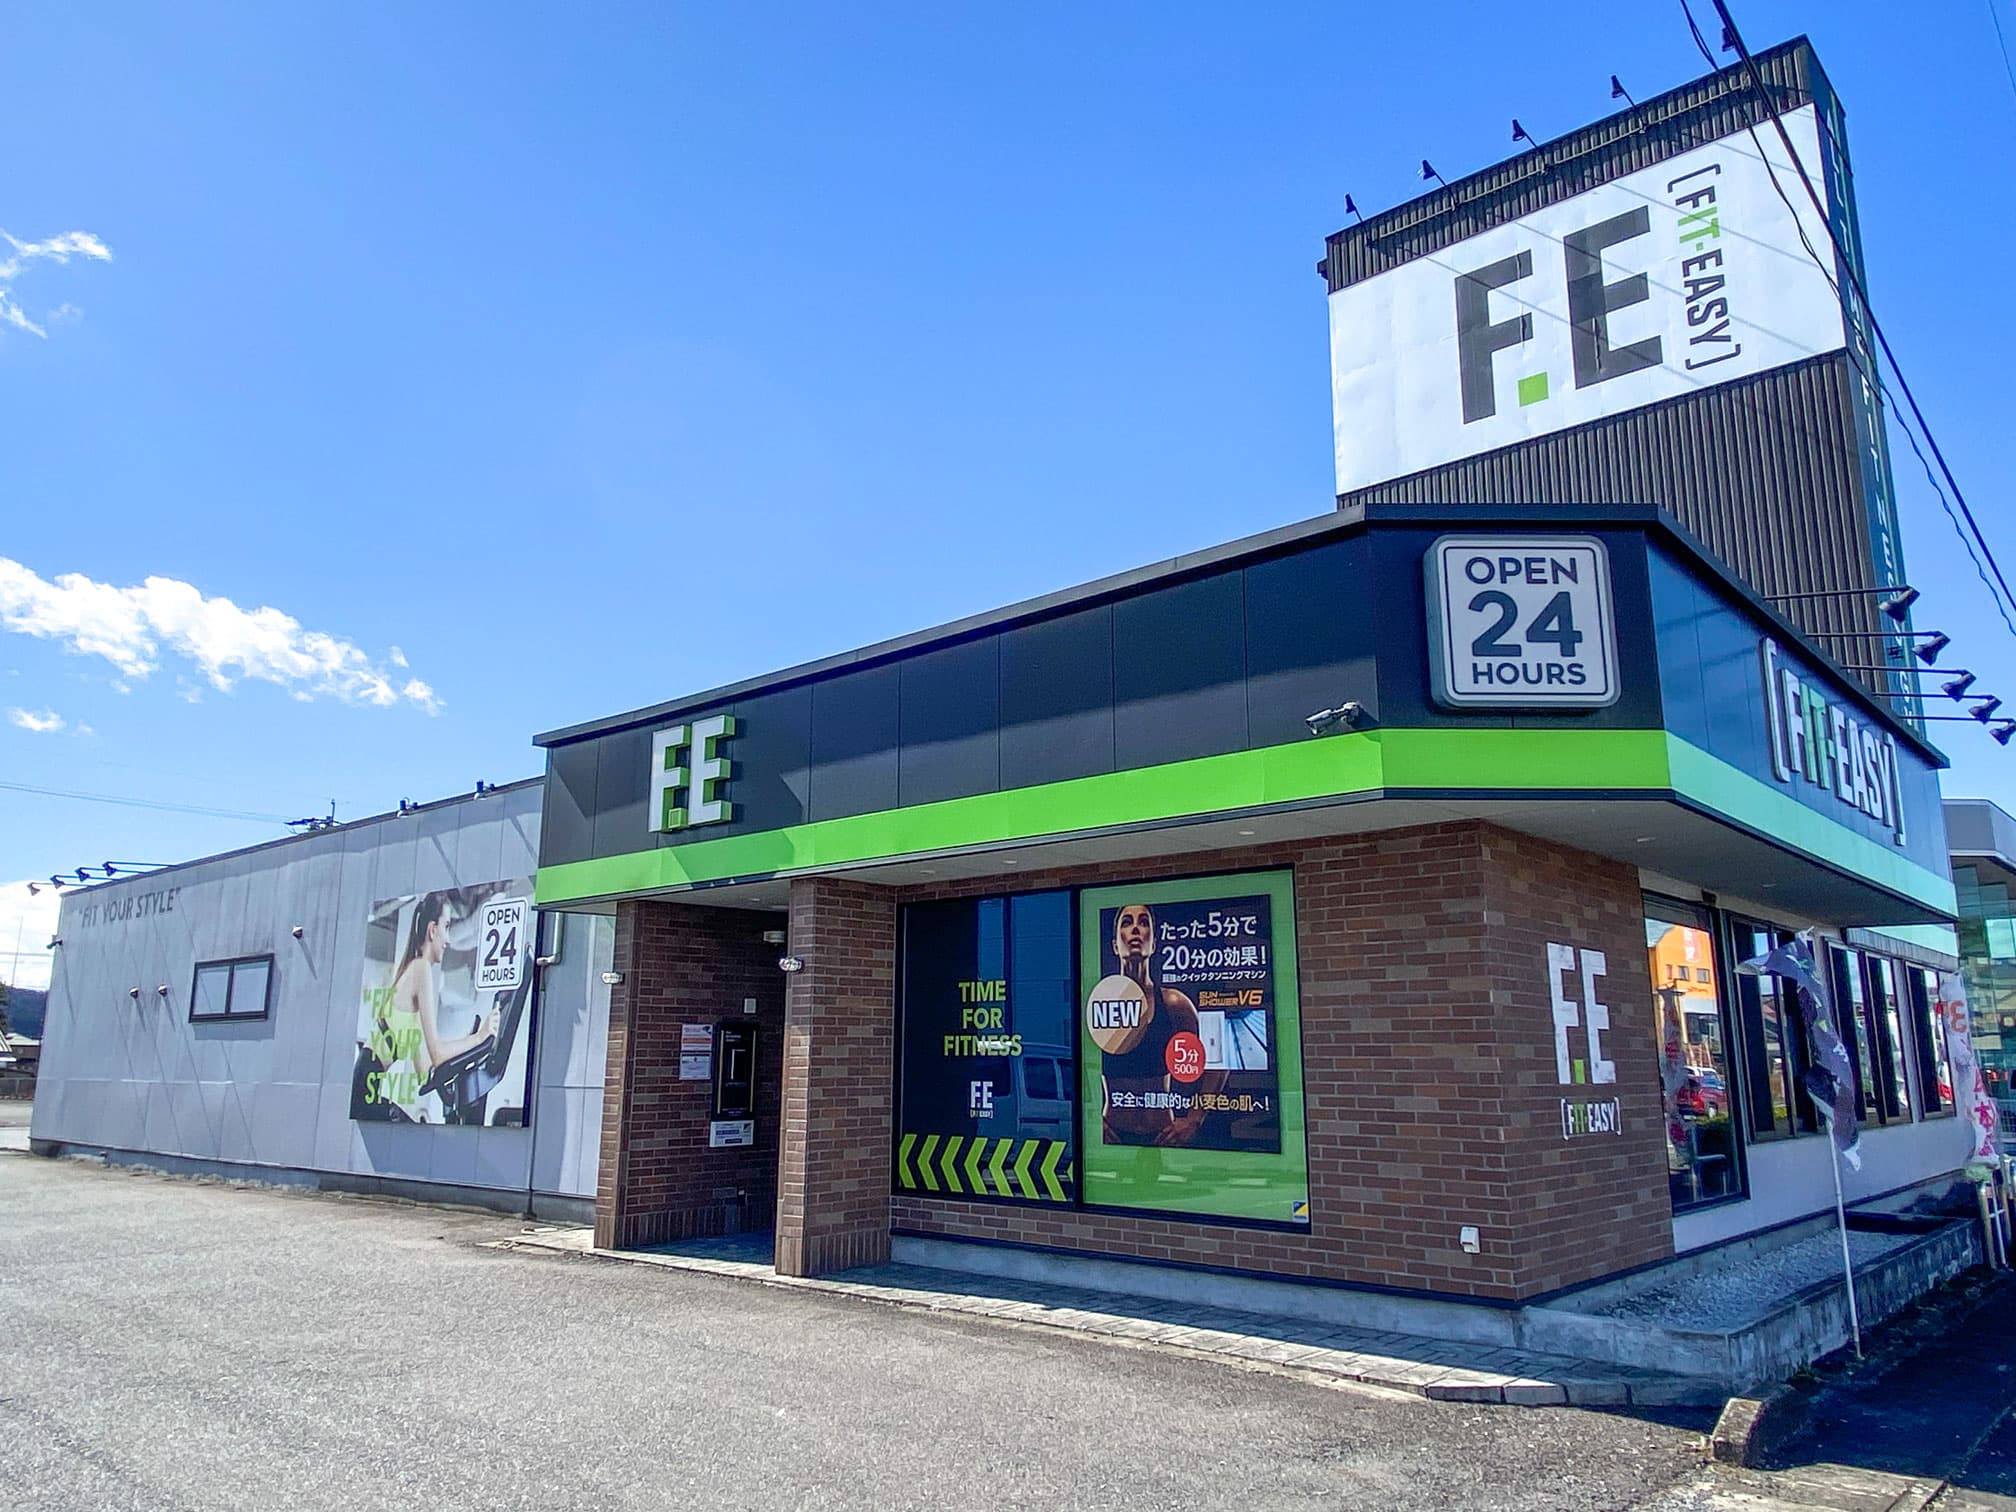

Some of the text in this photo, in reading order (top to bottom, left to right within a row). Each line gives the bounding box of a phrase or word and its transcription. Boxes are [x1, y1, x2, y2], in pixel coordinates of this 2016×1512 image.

[1465, 557, 1578, 585] OPEN
[1468, 590, 1583, 658] 24
[1472, 662, 1587, 686] HOURS
[103, 897, 134, 924] YOUR
[487, 907, 520, 926] OPEN
[1160, 912, 1257, 941] たった5分で
[484, 926, 517, 967] 24
[1162, 945, 1267, 970] 20分の効果!
[482, 966, 516, 983] HOURS
[1162, 970, 1266, 982] のクイックタンニングマシン
[958, 980, 1006, 1002] TIME
[962, 1007, 1003, 1029] FOR
[1093, 1001, 1141, 1028] NEW
[370, 1028, 423, 1062] YOUR
[944, 1034, 1023, 1056] FITNESS
[1174, 1039, 1199, 1064] 5分
